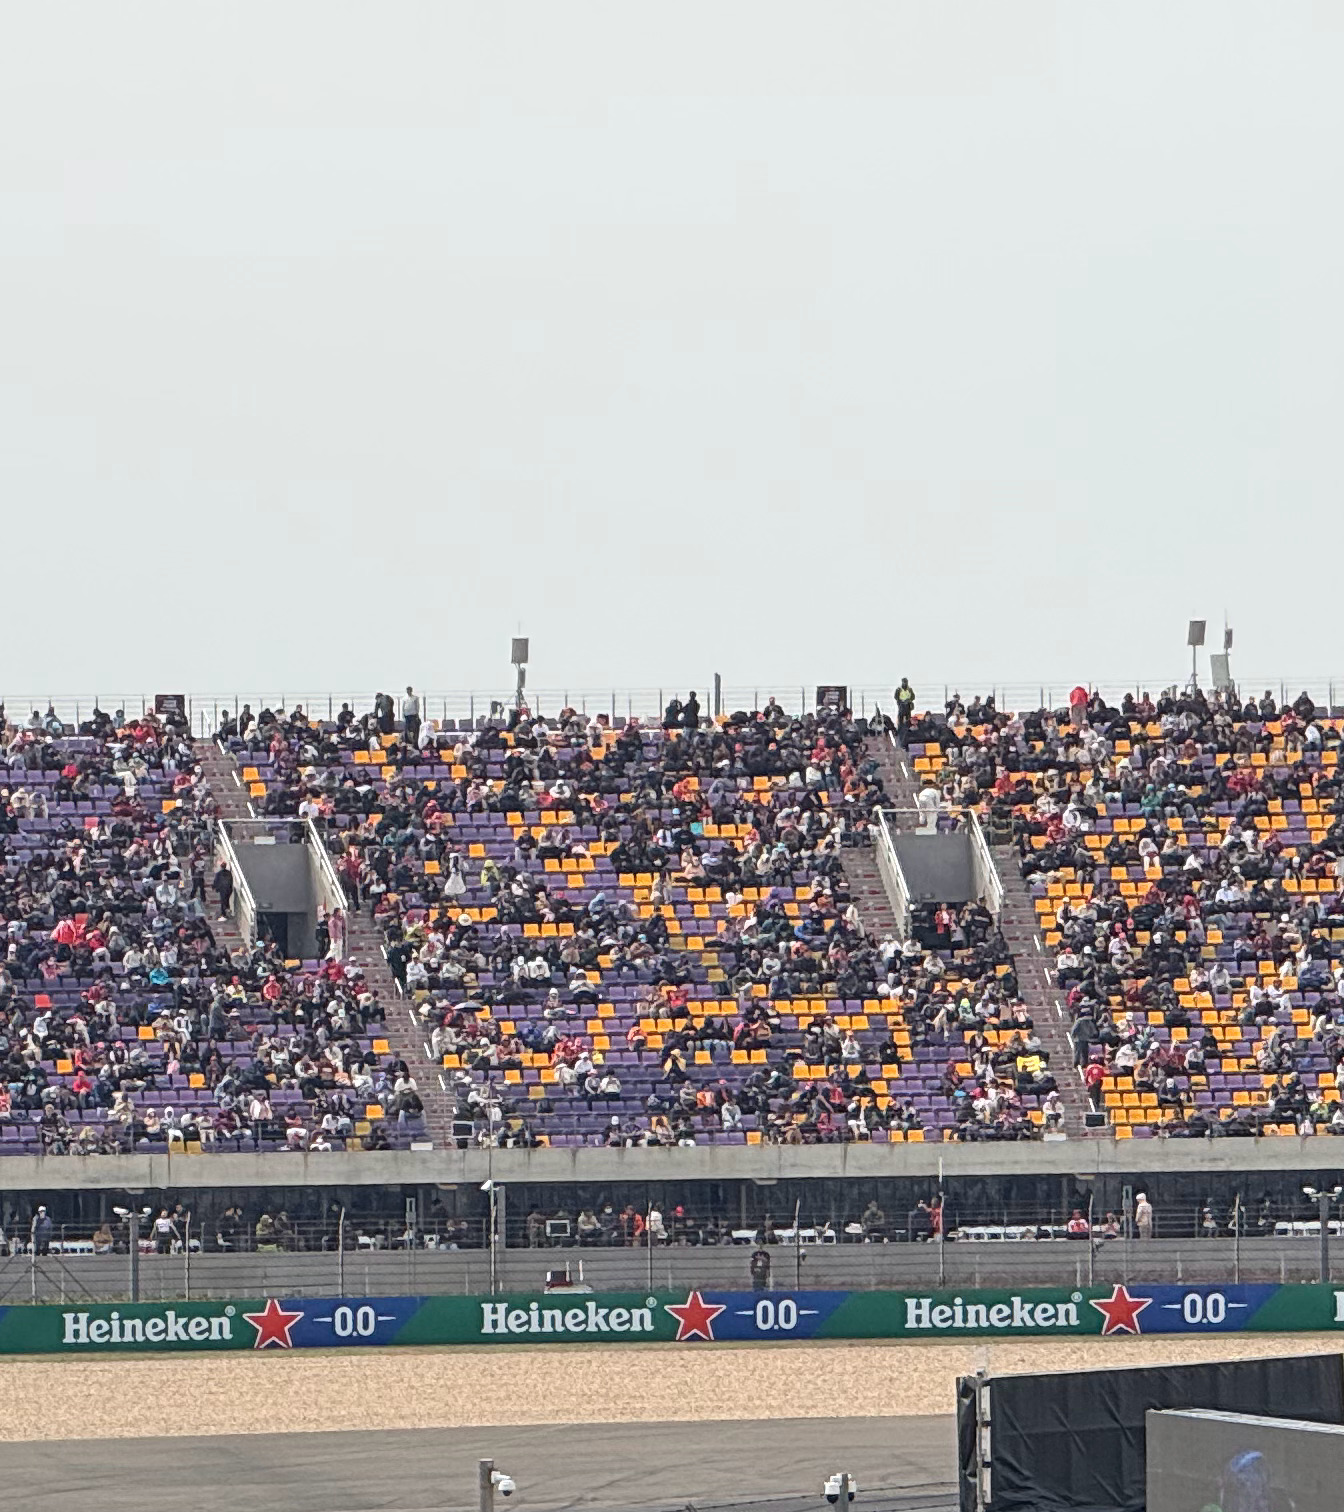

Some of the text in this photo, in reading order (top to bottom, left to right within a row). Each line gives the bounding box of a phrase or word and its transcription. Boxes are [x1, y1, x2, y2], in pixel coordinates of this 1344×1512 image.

[62, 1307, 234, 1344] Heineken
[481, 1298, 654, 1334] Heineken
[905, 1293, 1081, 1329] Heineken
